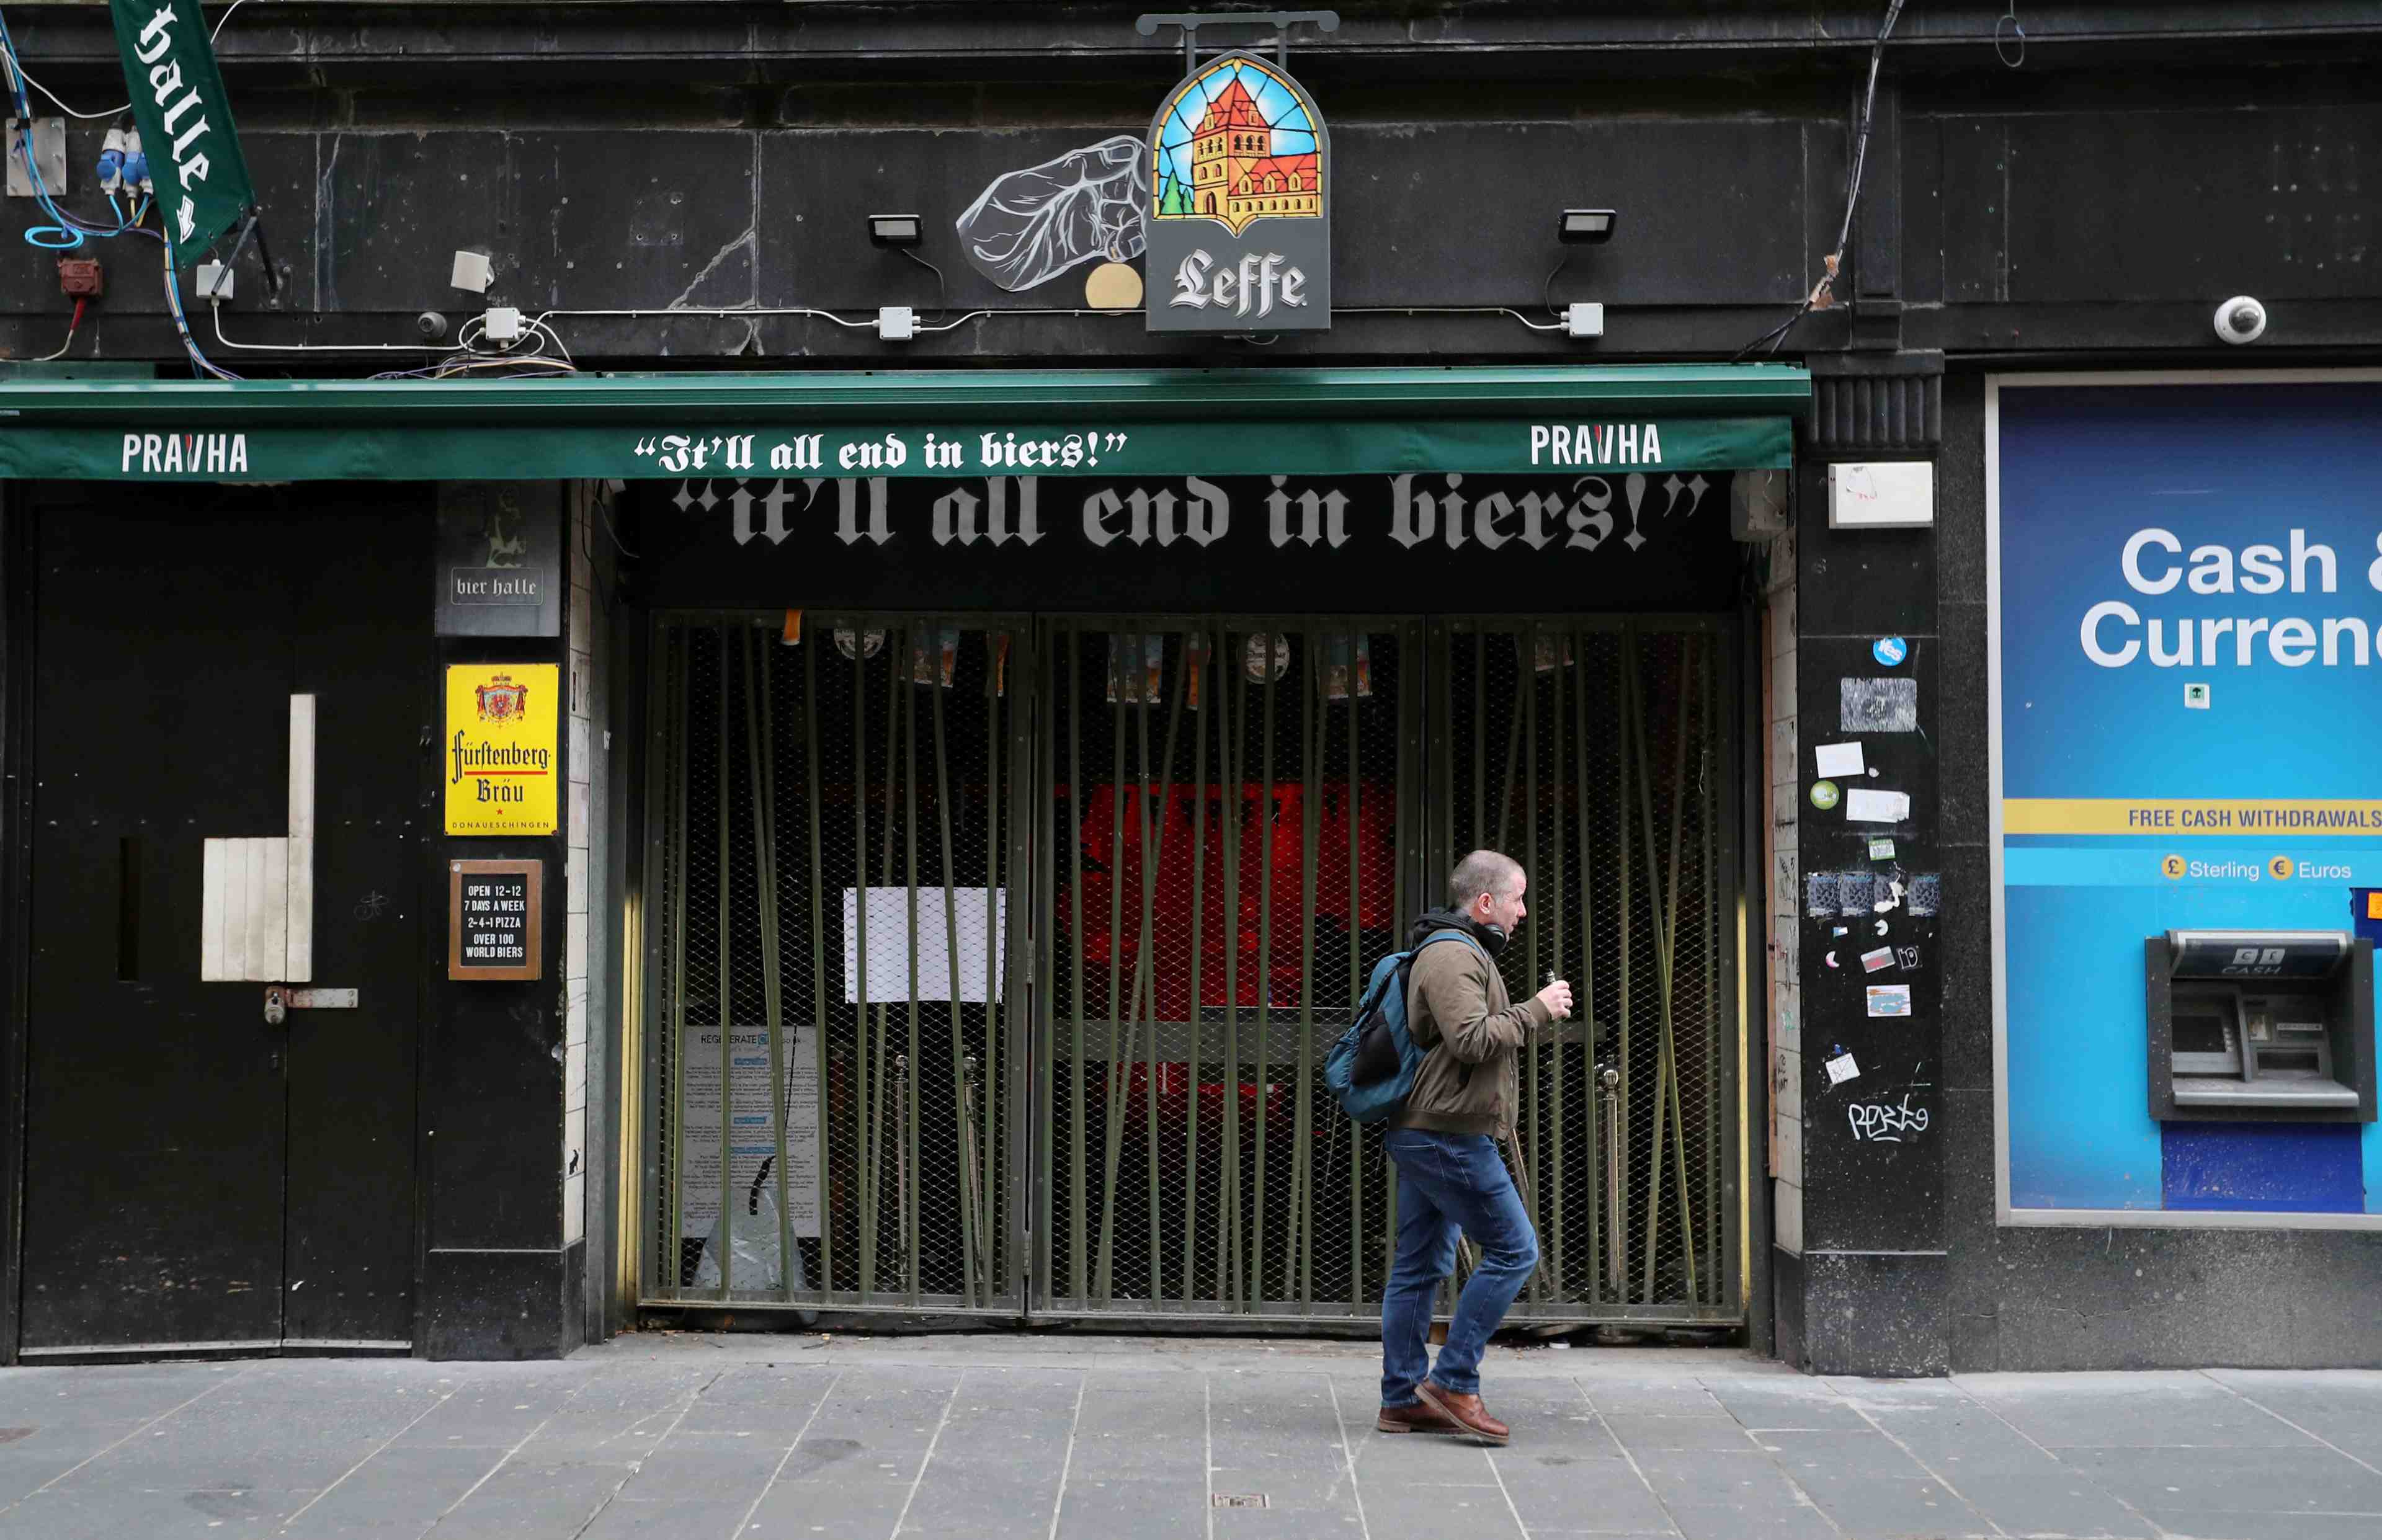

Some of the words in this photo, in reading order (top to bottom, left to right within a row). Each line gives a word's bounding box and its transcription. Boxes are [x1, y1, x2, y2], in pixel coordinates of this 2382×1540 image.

[134, 2, 210, 192] halle
[1169, 249, 1304, 318] Leffe
[122, 434, 248, 473] PRAVHA
[770, 434, 824, 470] all
[839, 433, 907, 470] end
[923, 433, 964, 468] in
[1530, 424, 1662, 465] PRAVHA
[932, 477, 1046, 547] all
[1082, 476, 1229, 548] end
[1264, 475, 1352, 548] in
[2121, 528, 2337, 595] Cash
[457, 578, 487, 595] bier
[493, 578, 537, 597] halle
[2080, 600, 2382, 667] Curren
[476, 778, 524, 803] Bräu
[2129, 810, 2175, 827] FREE
[2182, 810, 2231, 827] CASH
[2239, 810, 2382, 827] WITHDRAWALS
[2190, 861, 2260, 882] Sterling
[2299, 862, 2352, 879] Euros
[468, 885, 491, 896] OPEN
[495, 885, 522, 896] 12-12
[464, 900, 470, 911] 7
[471, 900, 491, 911] DAYS
[493, 900, 499, 911] A
[501, 900, 525, 911] WEEK
[496, 917, 521, 928] PIZZA
[473, 933, 496, 945] OVER
[499, 933, 514, 945] 100
[466, 946, 495, 958] WORLD
[497, 946, 523, 958] BIERS
[2221, 966, 2282, 974] CASH
